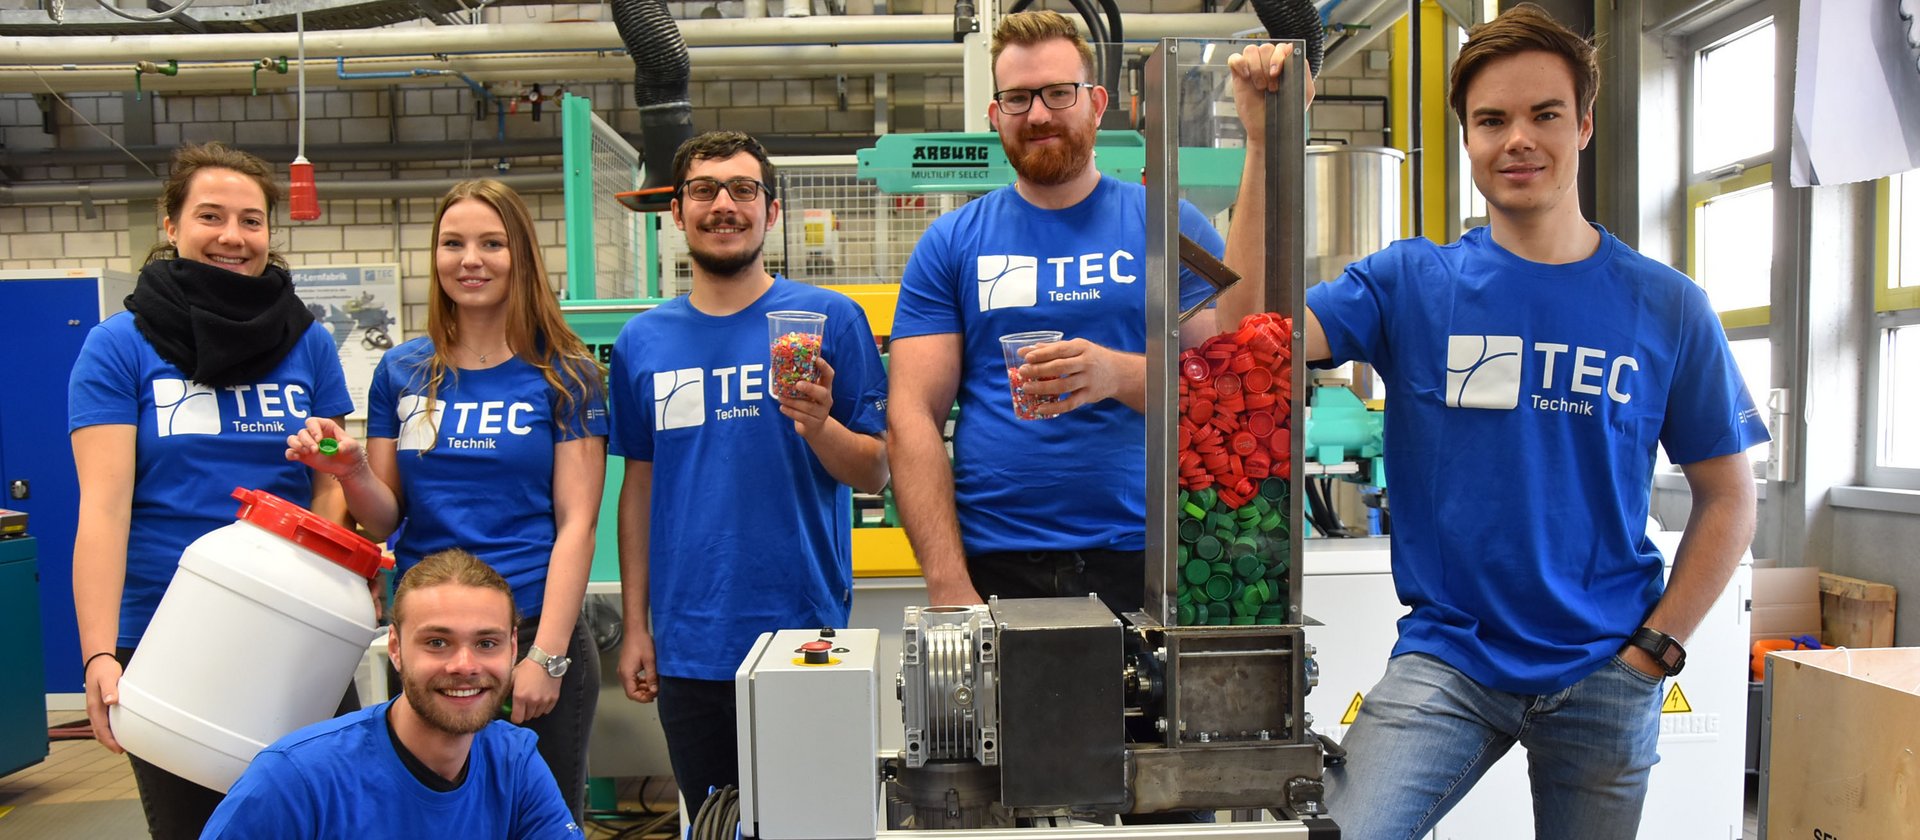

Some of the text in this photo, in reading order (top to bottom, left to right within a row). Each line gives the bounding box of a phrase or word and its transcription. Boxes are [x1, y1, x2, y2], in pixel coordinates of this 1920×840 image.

[912, 146, 989, 160] ARBURG
[911, 171, 989, 179] MULTILIFT SELECT
[1046, 249, 1137, 288] TEC
[1048, 288, 1101, 302] Technik
[1534, 342, 1639, 404] TEC
[712, 363, 780, 404] TE
[224, 383, 308, 419] TEC
[1531, 395, 1594, 416] Technik
[453, 401, 535, 436] TEC
[715, 405, 760, 421] Technik
[232, 420, 286, 433] Technik
[447, 437, 496, 449] Technik
